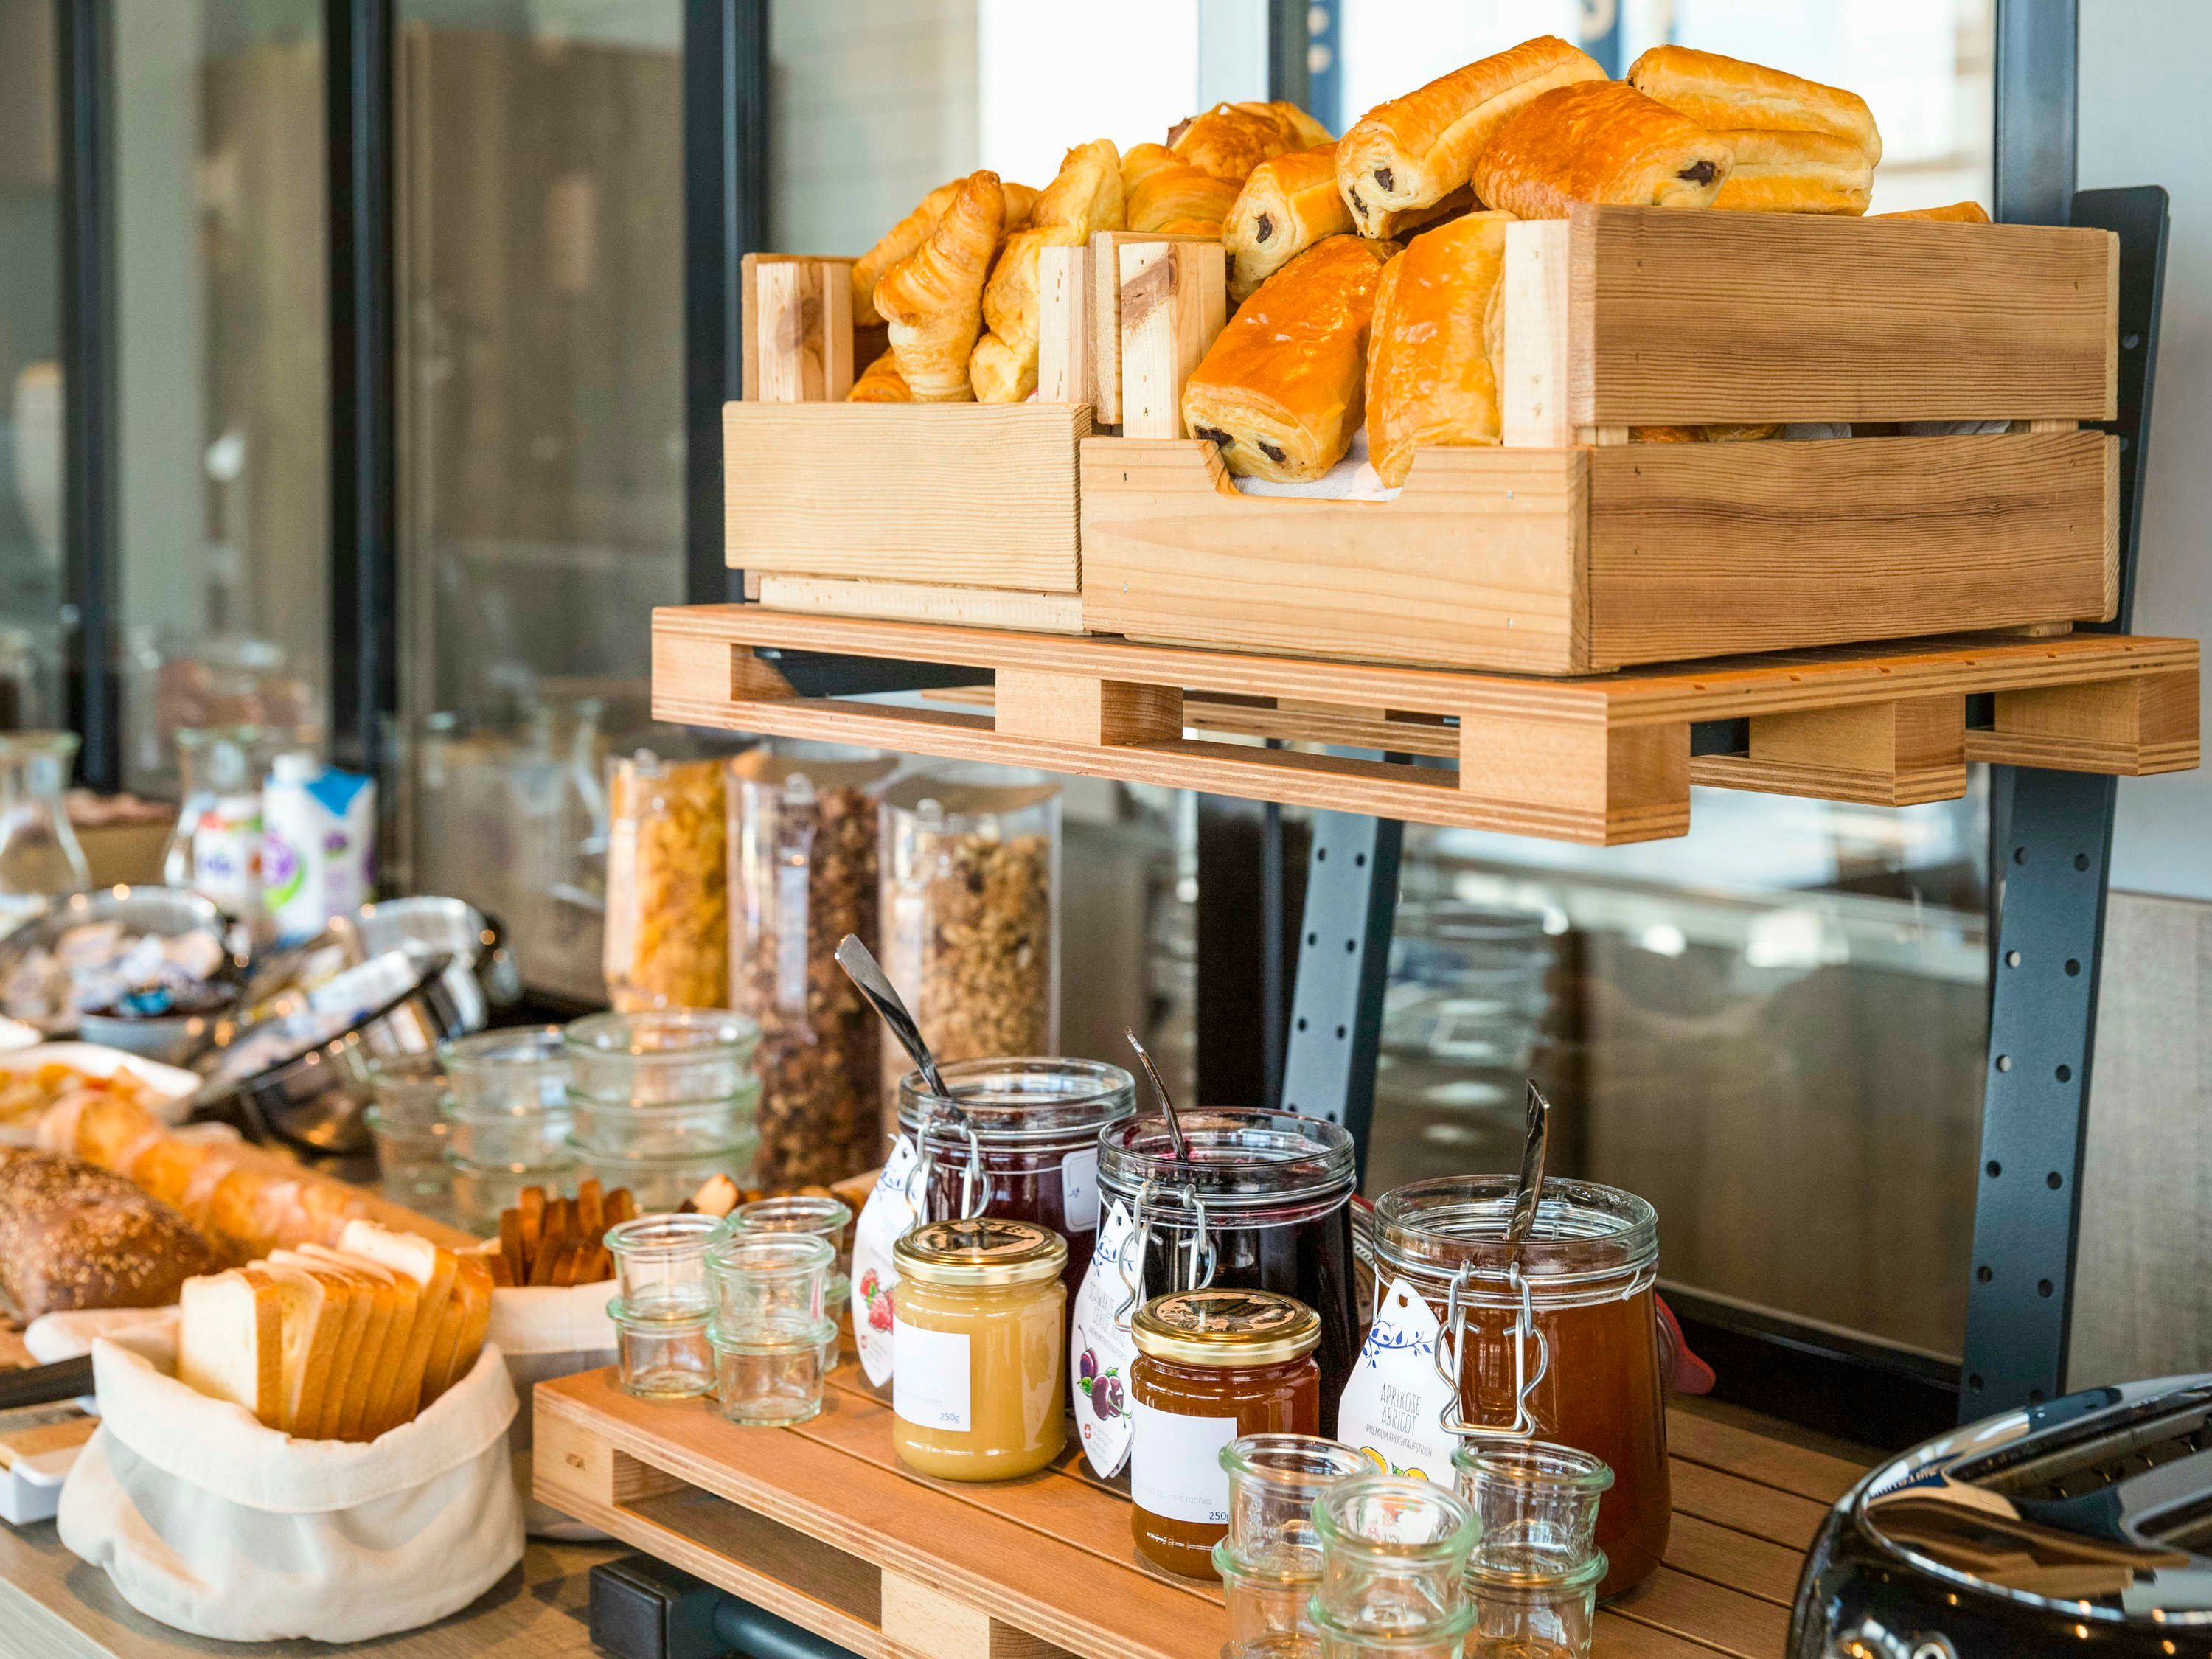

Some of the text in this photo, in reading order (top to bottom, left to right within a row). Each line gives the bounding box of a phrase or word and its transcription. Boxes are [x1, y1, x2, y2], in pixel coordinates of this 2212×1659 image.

[1380, 1383, 1422, 1416] APRIKOSE
[940, 1412, 960, 1424] 250g
[1381, 1405, 1416, 1436] ABRICOT
[1366, 1423, 1388, 1440] PREMIUM
[1185, 1495, 1214, 1506] ruches
